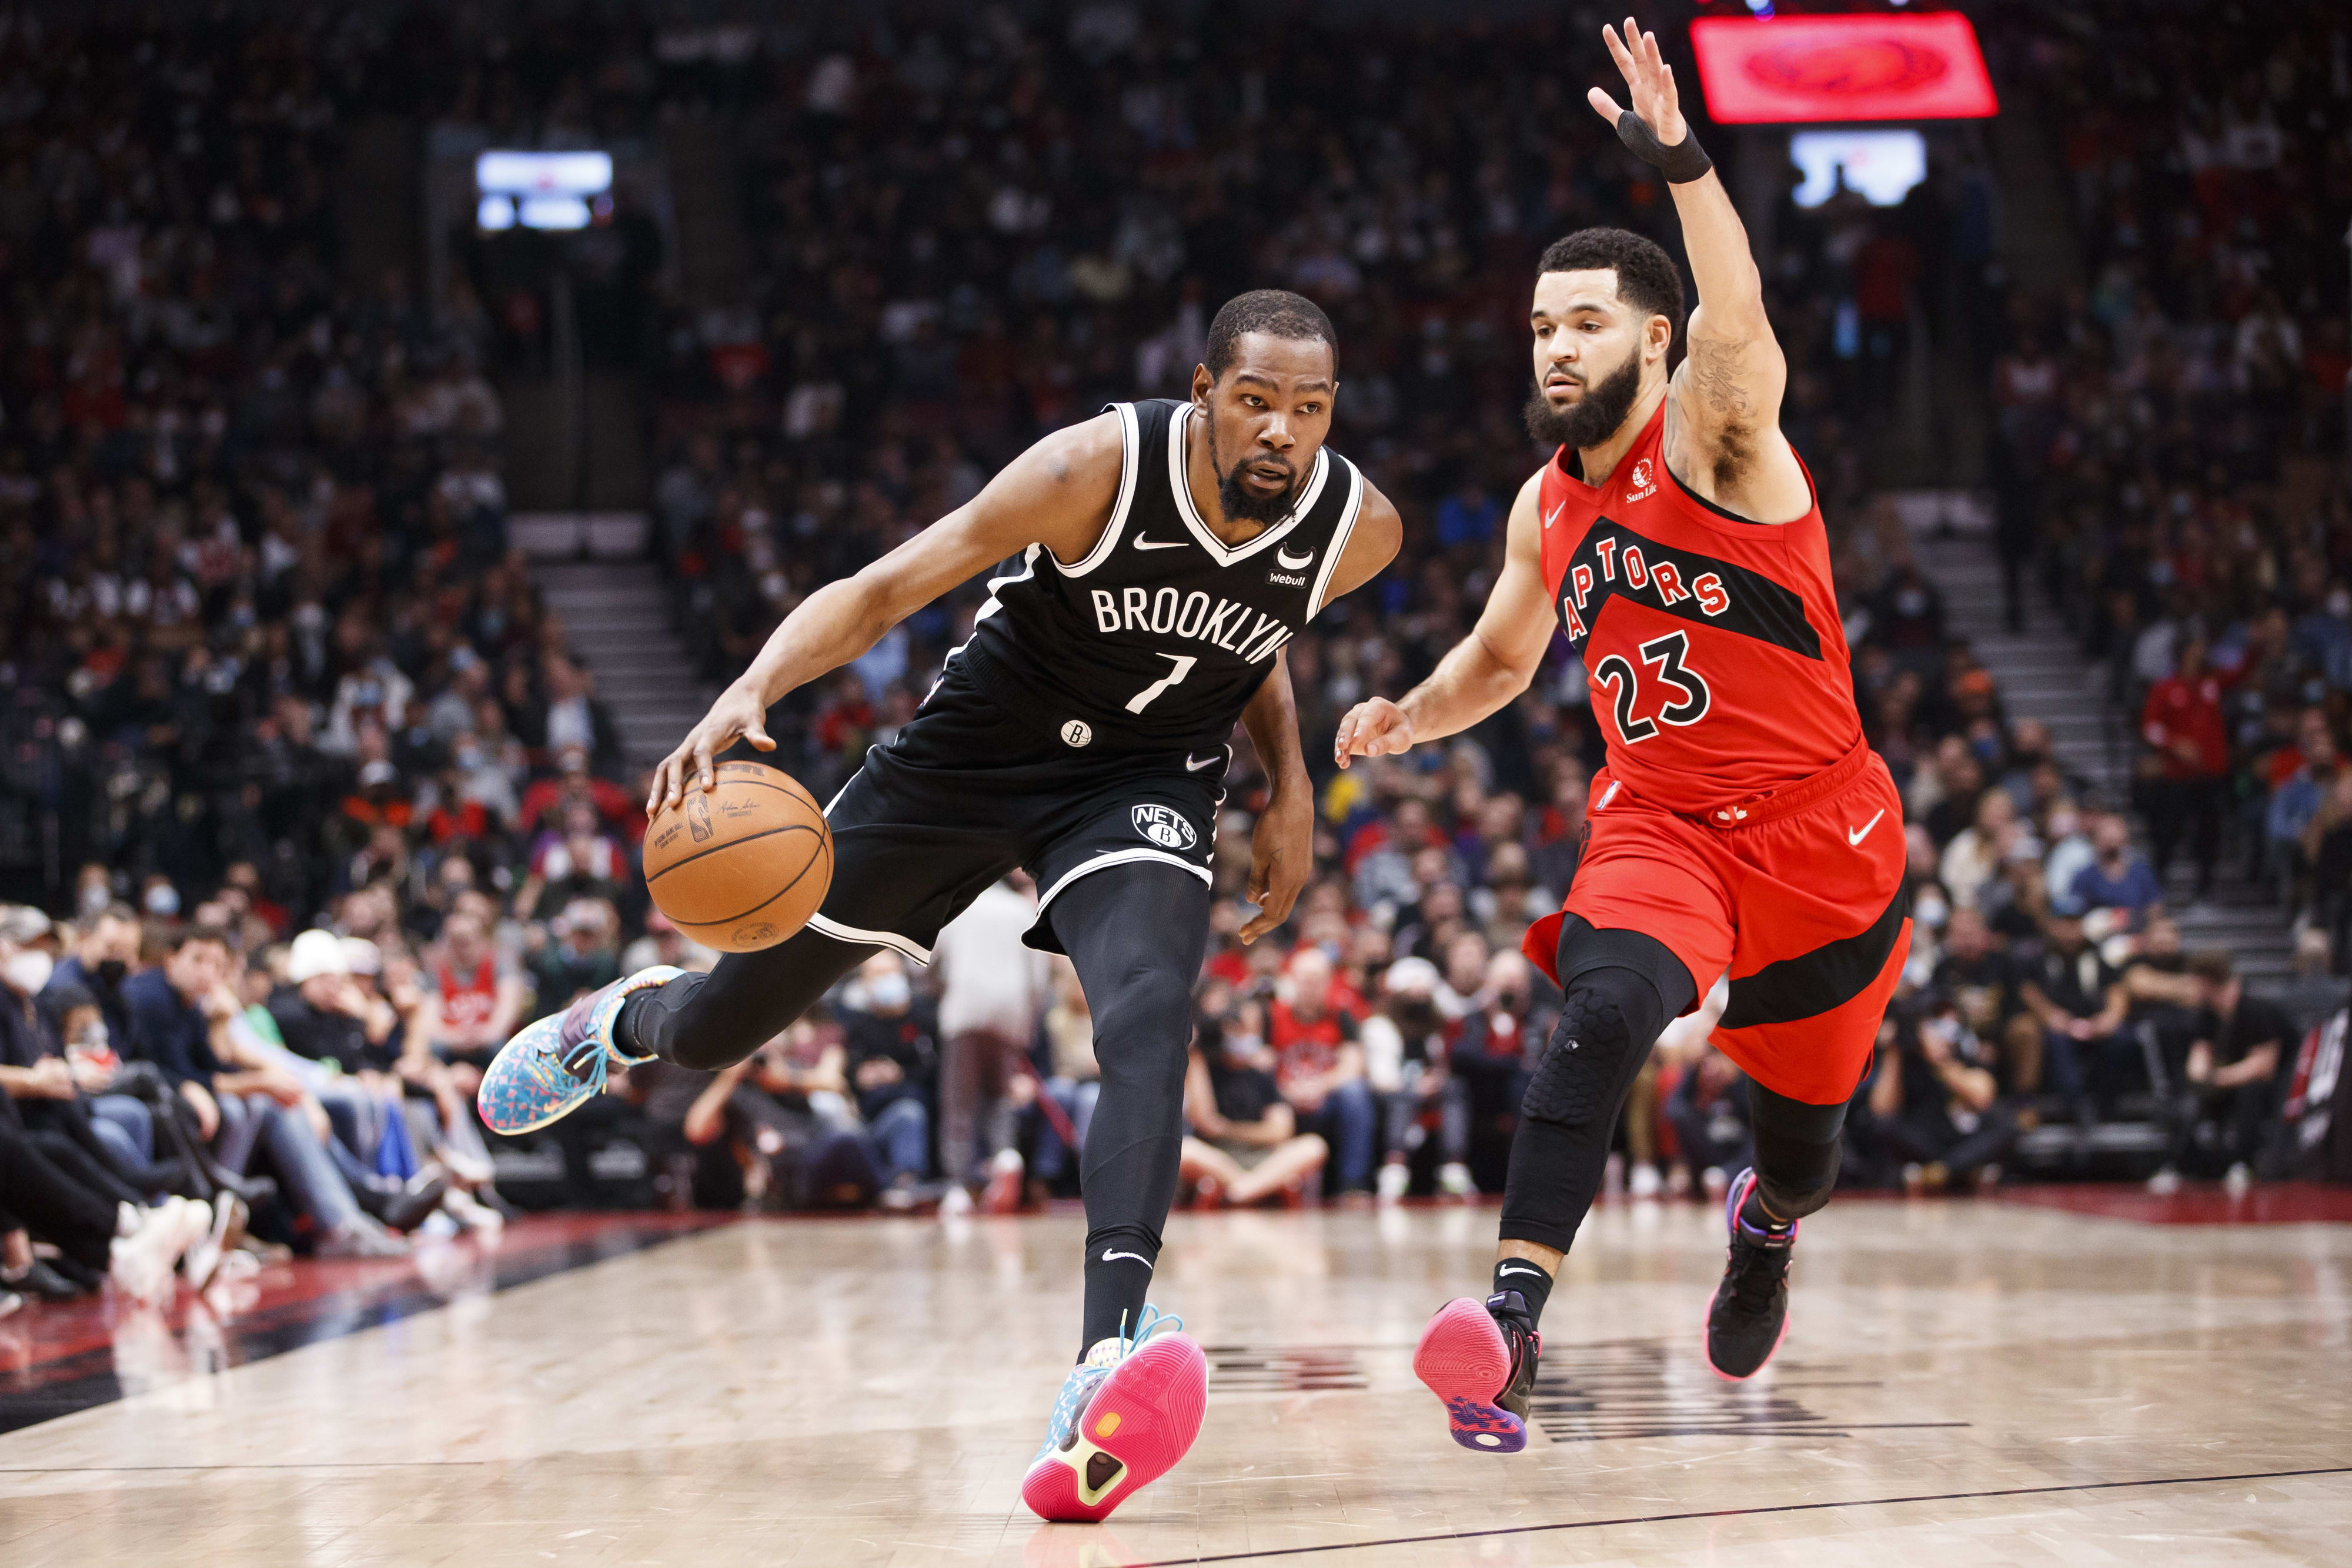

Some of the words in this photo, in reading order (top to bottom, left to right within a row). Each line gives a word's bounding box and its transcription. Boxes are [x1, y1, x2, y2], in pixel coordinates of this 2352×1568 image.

[1626, 492, 1644, 504] Sun
[1645, 482, 1657, 497] Life
[1270, 573, 1306, 587] Webull
[1564, 536, 1730, 643] APTORS
[1091, 587, 1294, 665] BROOKLYN
[1124, 652, 1198, 715] 7
[1594, 629, 1711, 745] 23
[1068, 724, 1084, 744] B
[1136, 807, 1194, 843] NETS
[1160, 827, 1171, 842] B
